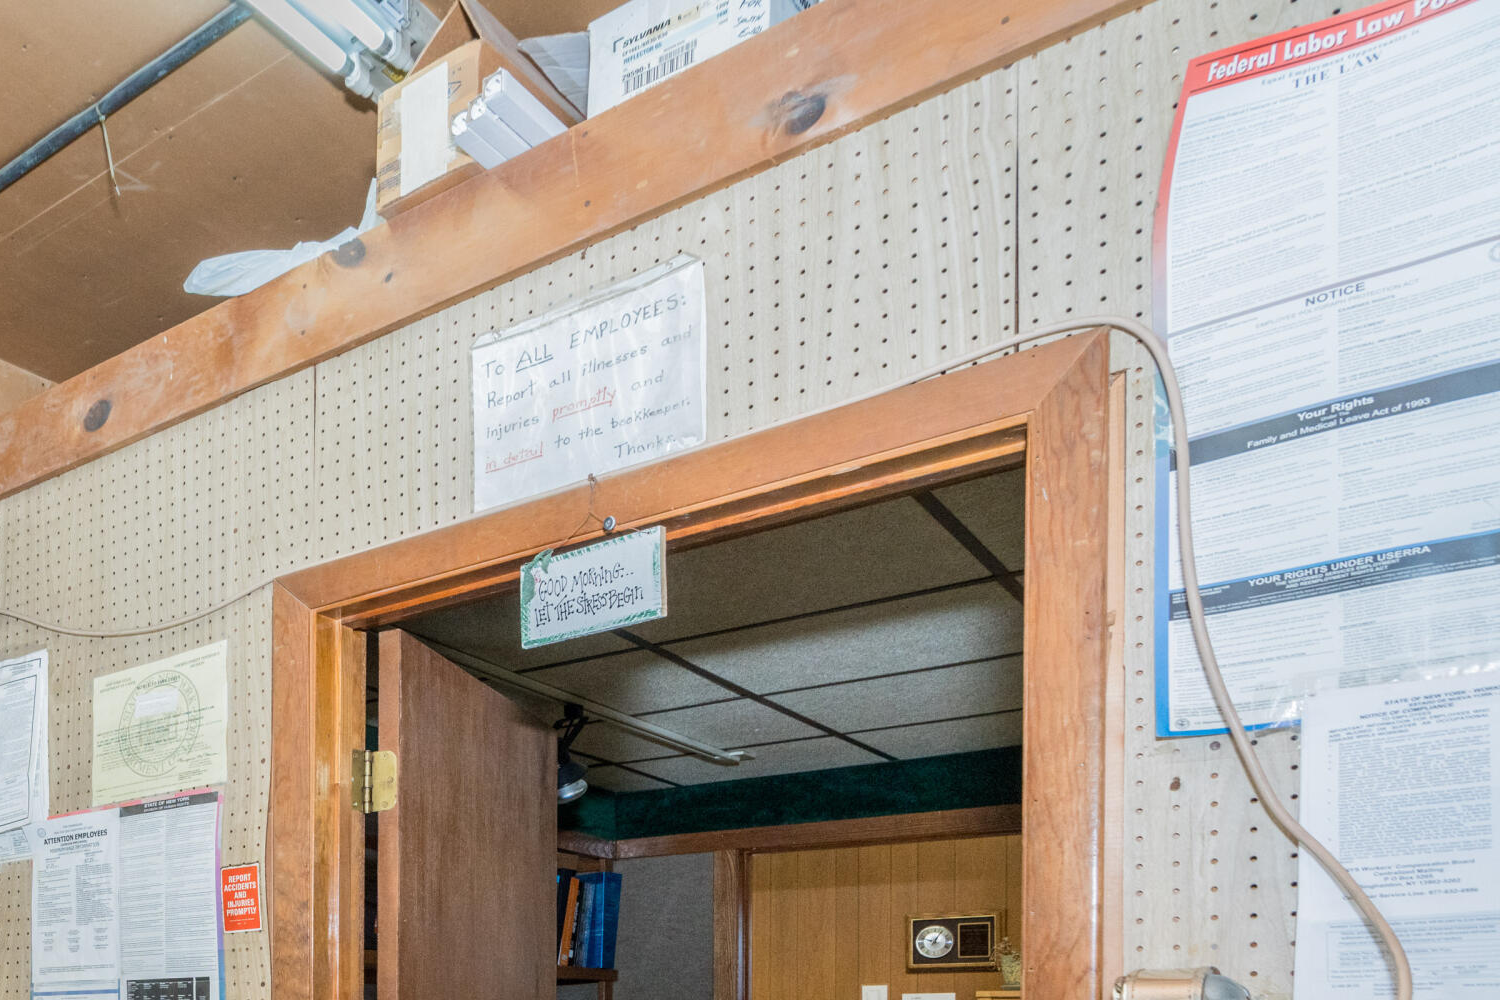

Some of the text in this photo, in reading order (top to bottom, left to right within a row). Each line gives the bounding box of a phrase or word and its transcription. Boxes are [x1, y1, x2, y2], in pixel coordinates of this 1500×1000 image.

[622, 19, 671, 48] SYLVANIA
[1206, 44, 1277, 83] Federal
[1283, 27, 1348, 62] Labor
[1356, 10, 1404, 39] Law
[1292, 51, 1381, 88] THE LAW
[1304, 282, 1366, 307] NOTICE
[482, 293, 687, 379] To ALL EMPLOYEES:
[487, 325, 693, 409] Report all illnesses and
[486, 369, 664, 441] injuries promptly and
[1297, 395, 1375, 422] Your Rights
[1246, 396, 1431, 449] Family and Medical Leave Act of 1993
[485, 452, 498, 470] in
[503, 441, 544, 464] detail
[554, 434, 571, 449] to
[578, 425, 604, 440] the
[1248, 545, 1432, 588] YOUR RIGHTS UNDER USERRA
[539, 574, 568, 601] GOOD
[534, 602, 553, 628] LET
[554, 595, 575, 622] THE
[576, 592, 608, 616] STRESS
[44, 828, 108, 847] ATTENTION EMPLOYEES
[224, 881, 257, 892] ACCIDENTS
[228, 873, 252, 883] REPORT
[227, 898, 255, 908] INJURIES
[234, 891, 247, 899] AND
[226, 907, 257, 917] PROMPTLY
